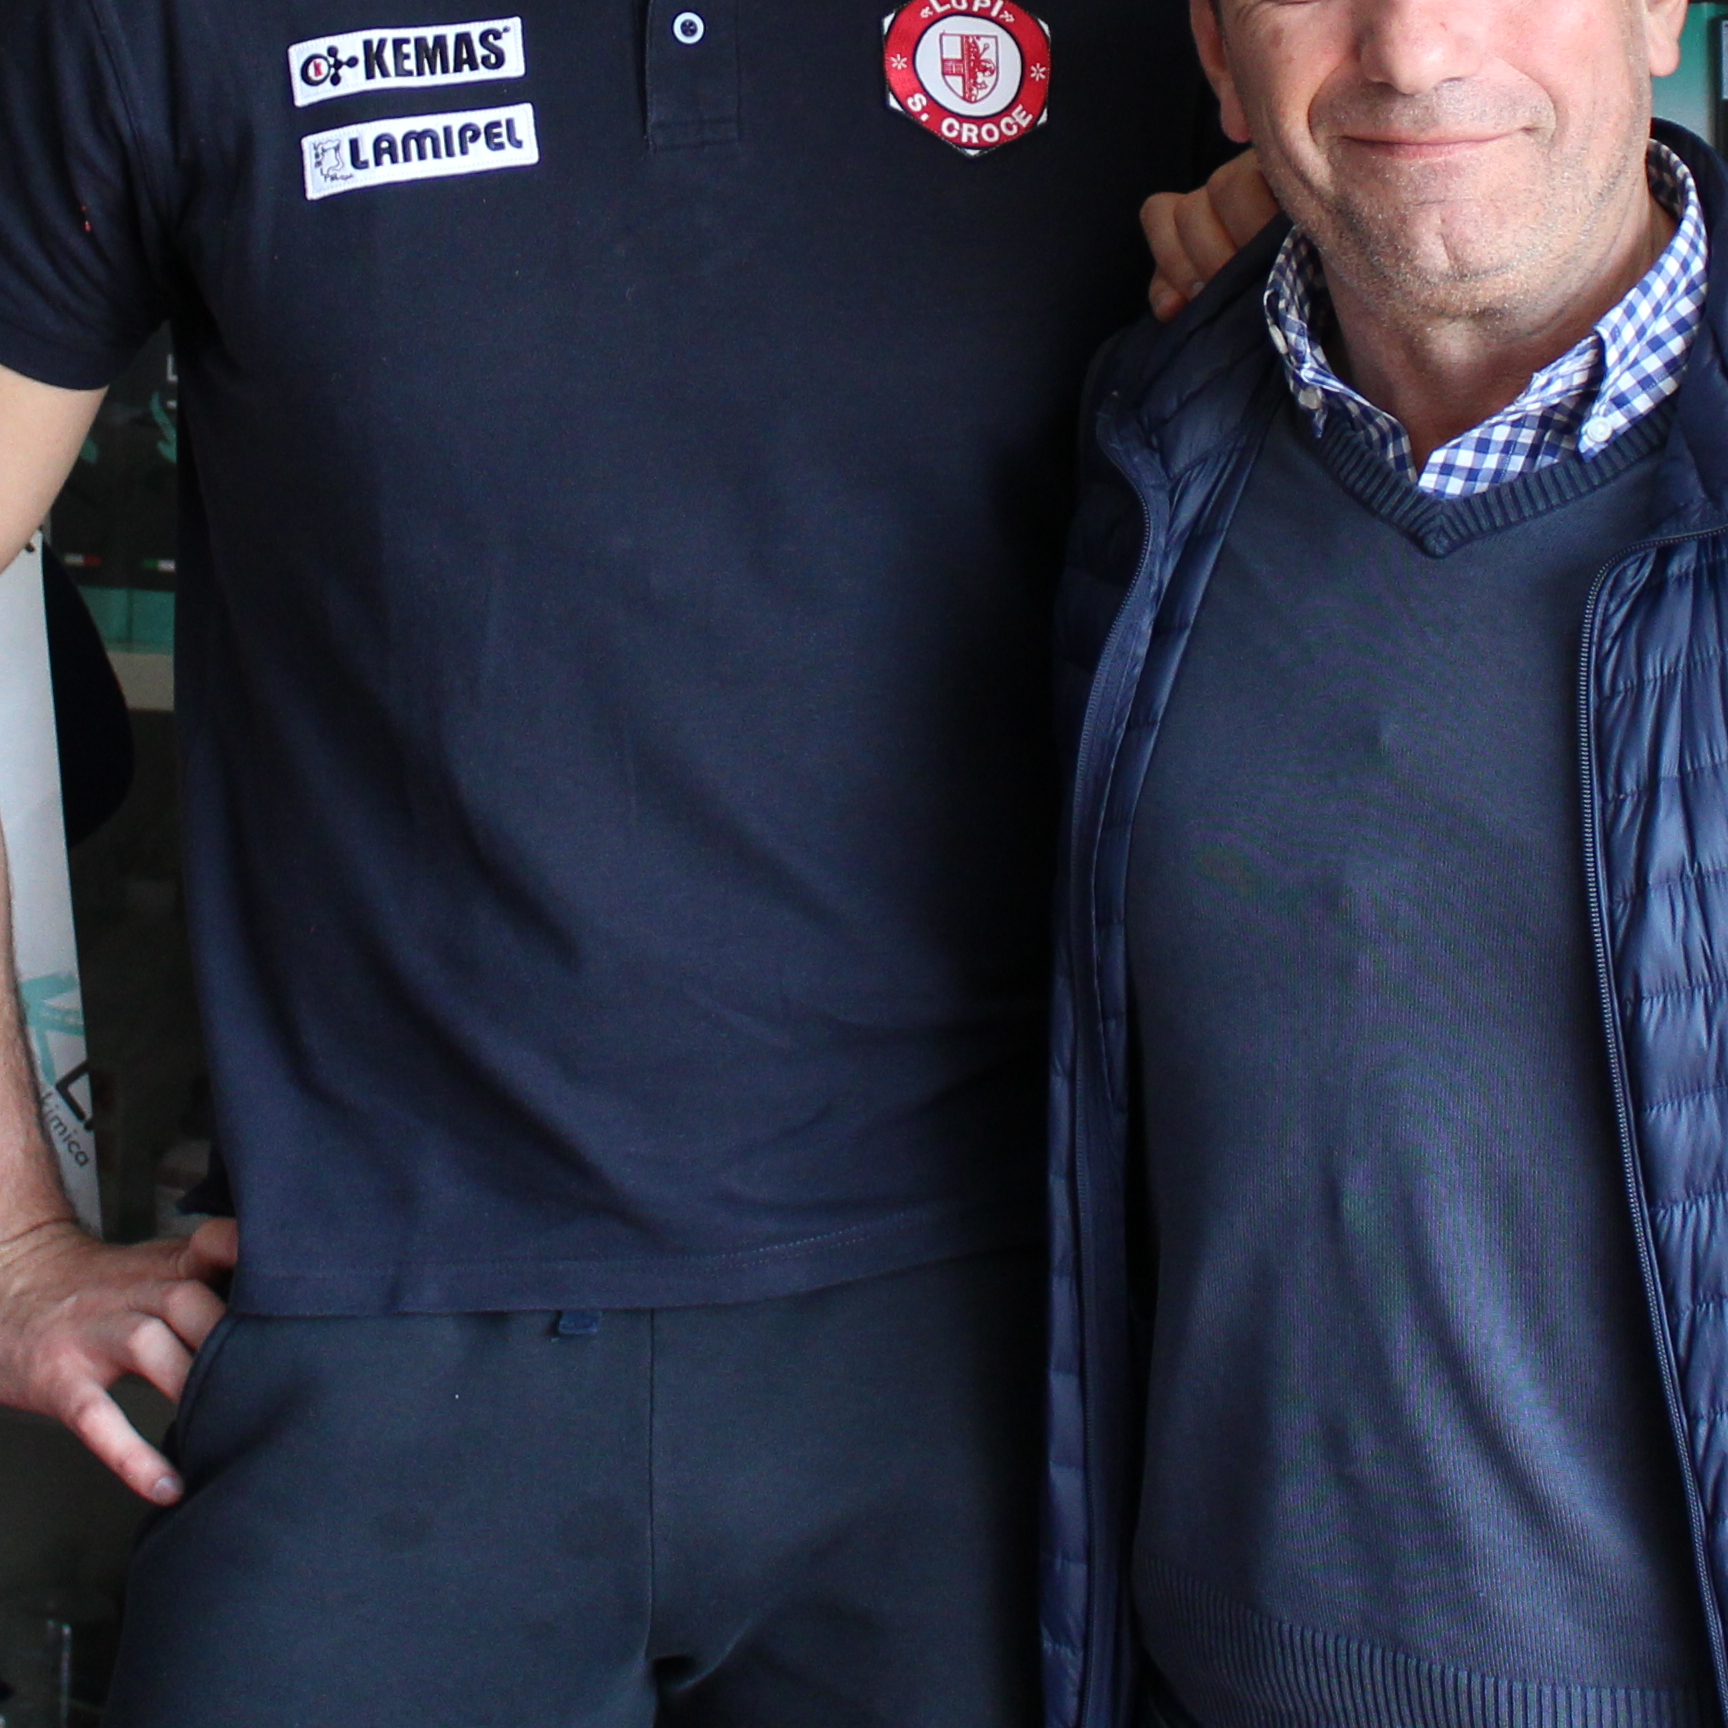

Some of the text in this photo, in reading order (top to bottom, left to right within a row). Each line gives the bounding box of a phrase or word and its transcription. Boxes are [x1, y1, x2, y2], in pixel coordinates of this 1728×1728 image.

[362, 28, 508, 81] KEMAS
[348, 117, 523, 172] LAMIPEL
[906, 92, 1034, 144] S. CROCE
